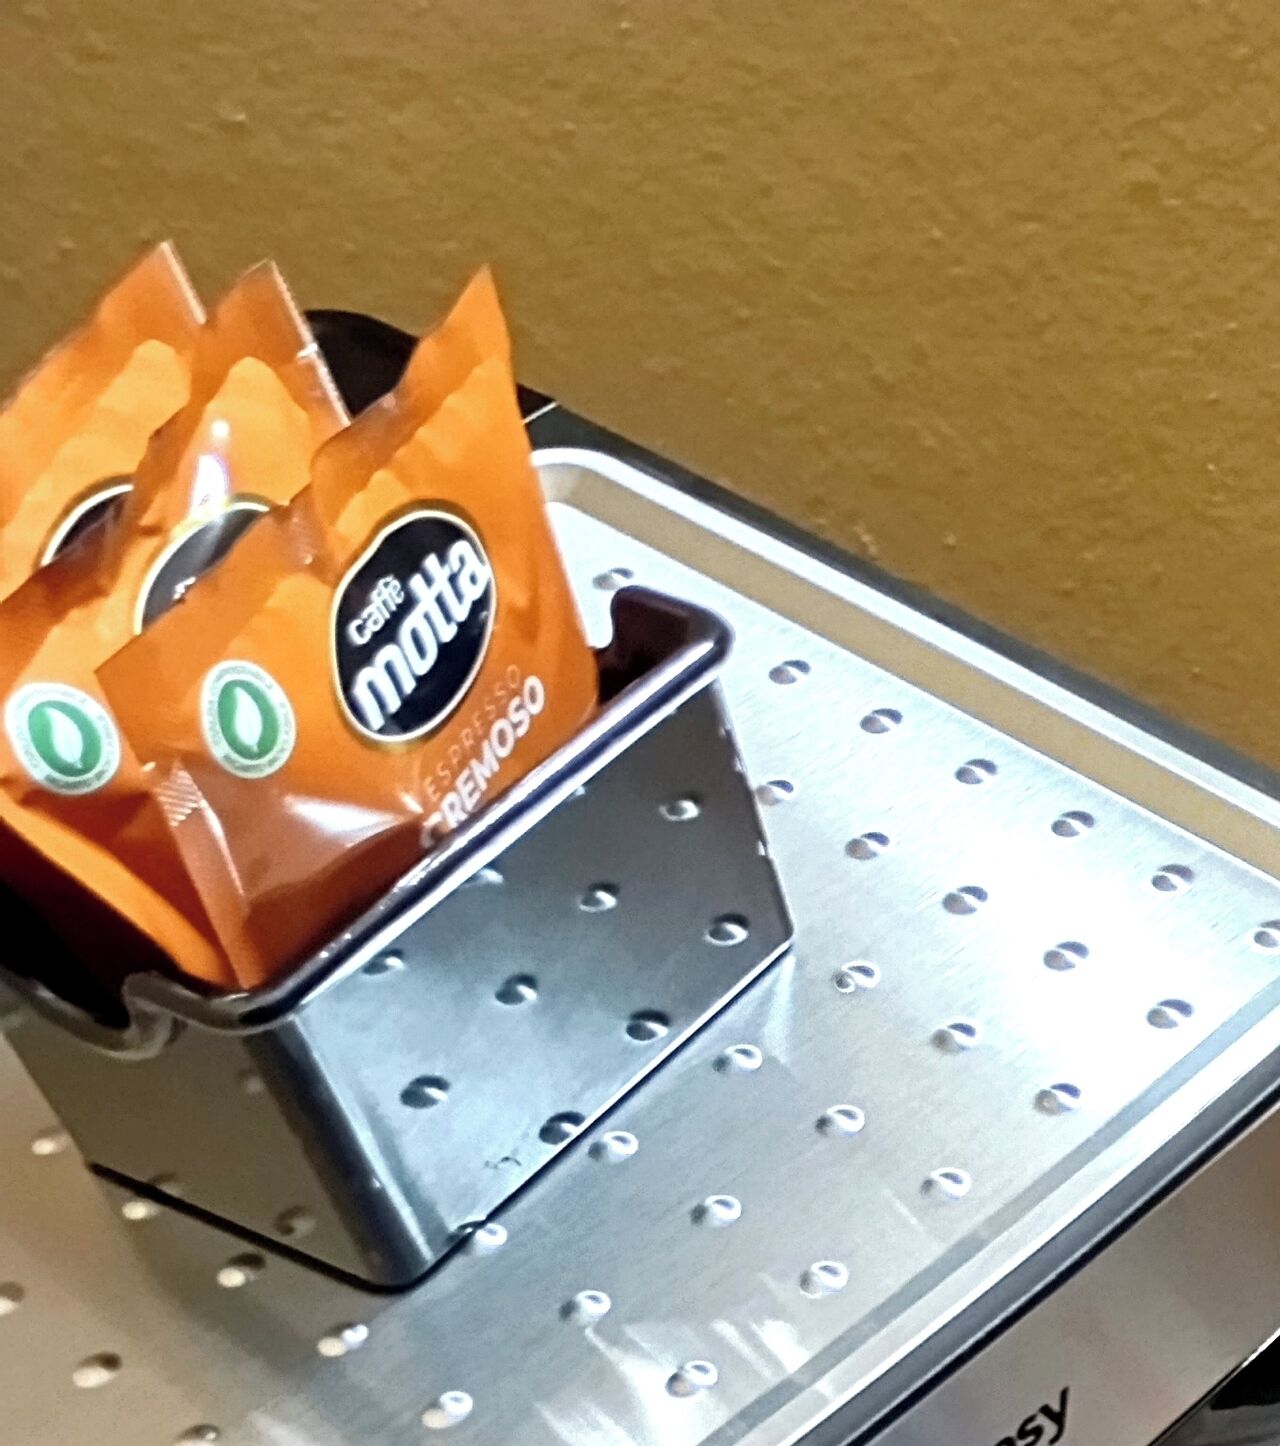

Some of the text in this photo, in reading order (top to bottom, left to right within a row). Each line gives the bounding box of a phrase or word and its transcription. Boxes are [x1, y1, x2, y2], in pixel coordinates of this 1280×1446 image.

[352, 540, 491, 731] motta
[420, 675, 544, 848] CREMOSO
[423, 664, 520, 800] ESPRESSO
